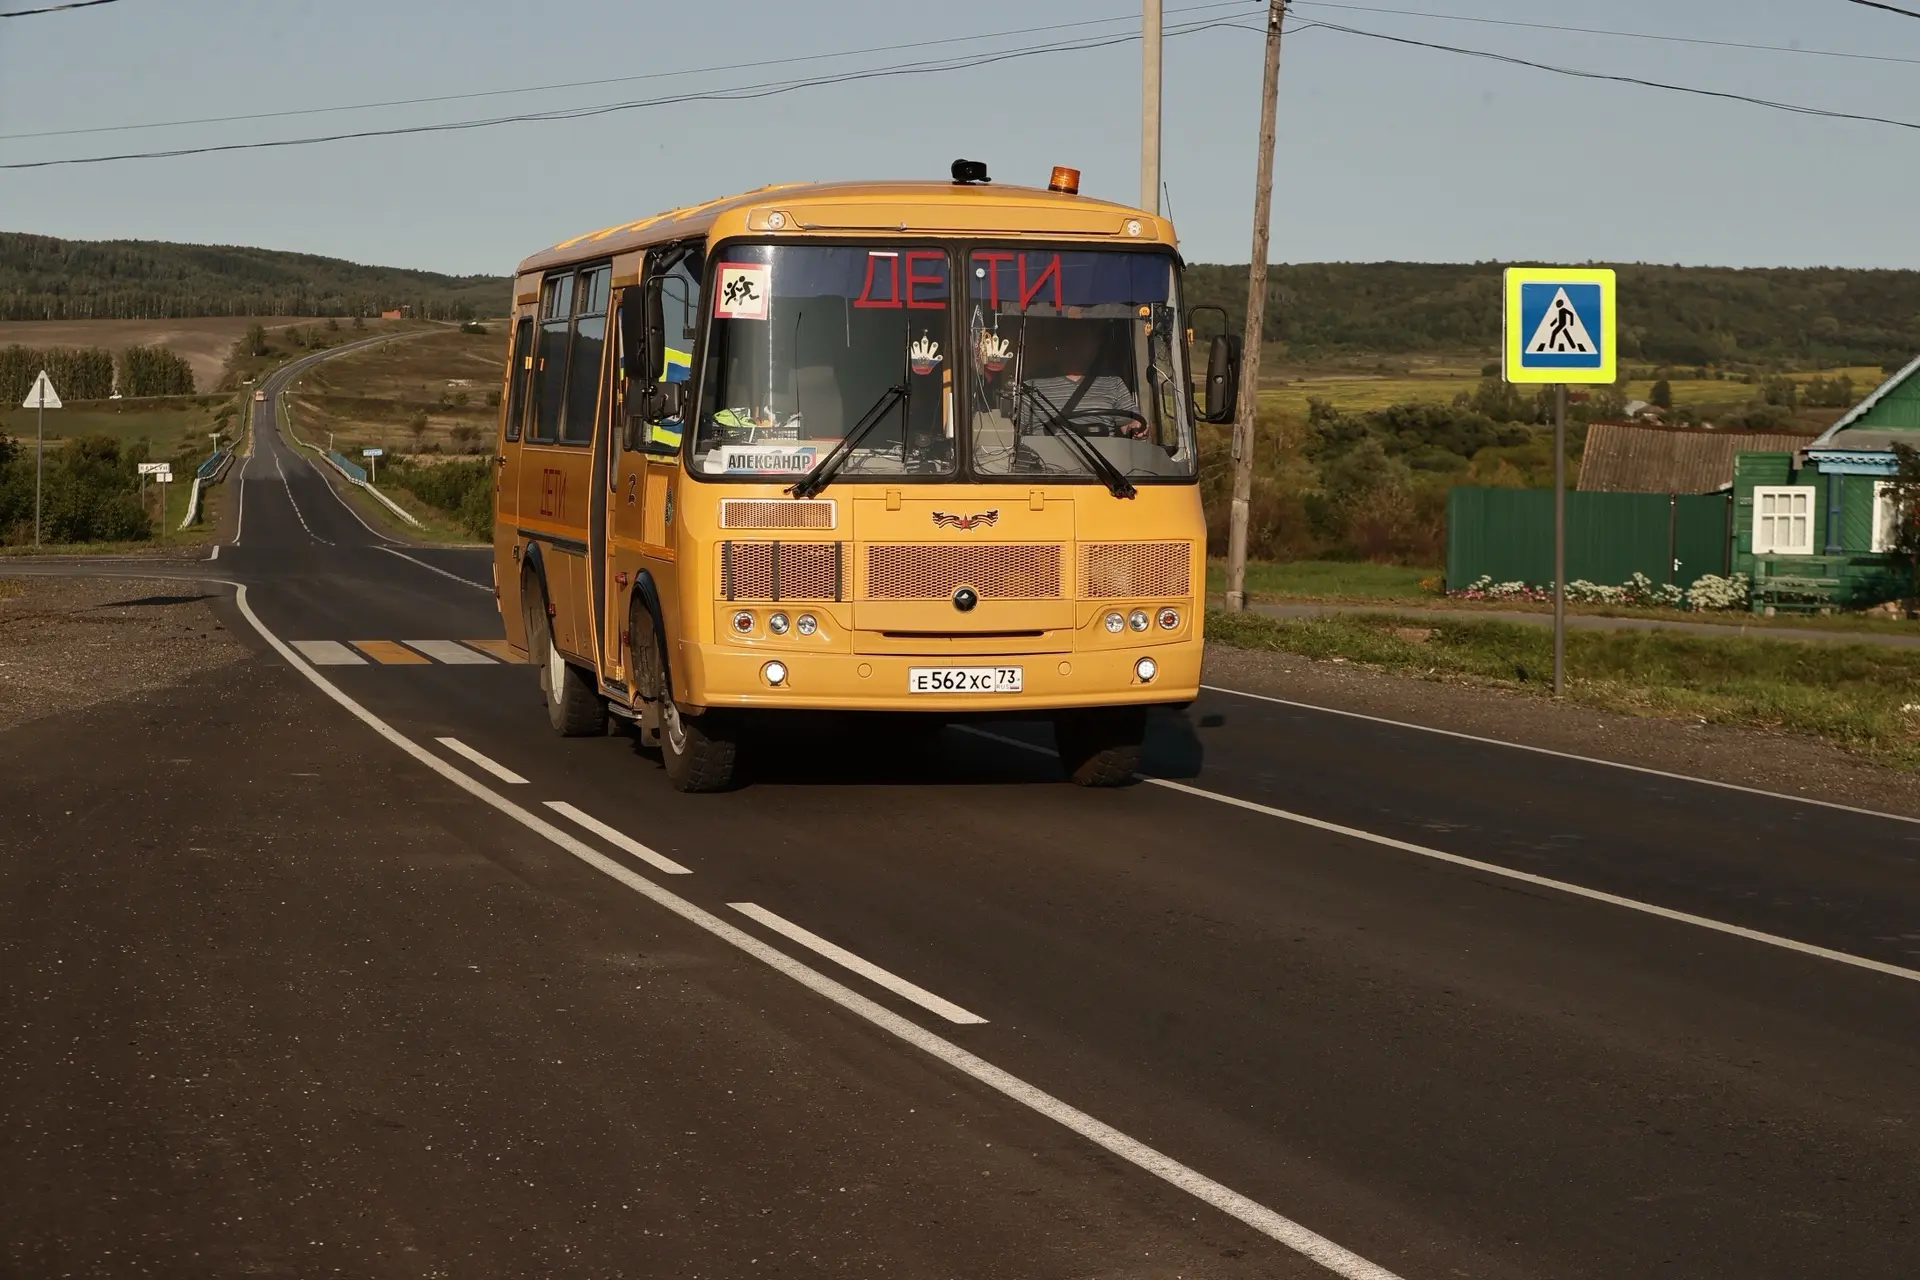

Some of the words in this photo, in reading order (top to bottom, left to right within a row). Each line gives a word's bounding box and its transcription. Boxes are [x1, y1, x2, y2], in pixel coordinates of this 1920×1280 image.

[728, 454, 811, 471] АЛЕКСАНДР
[540, 468, 567, 519] ДЕТИ
[998, 670, 1016, 684] 73
